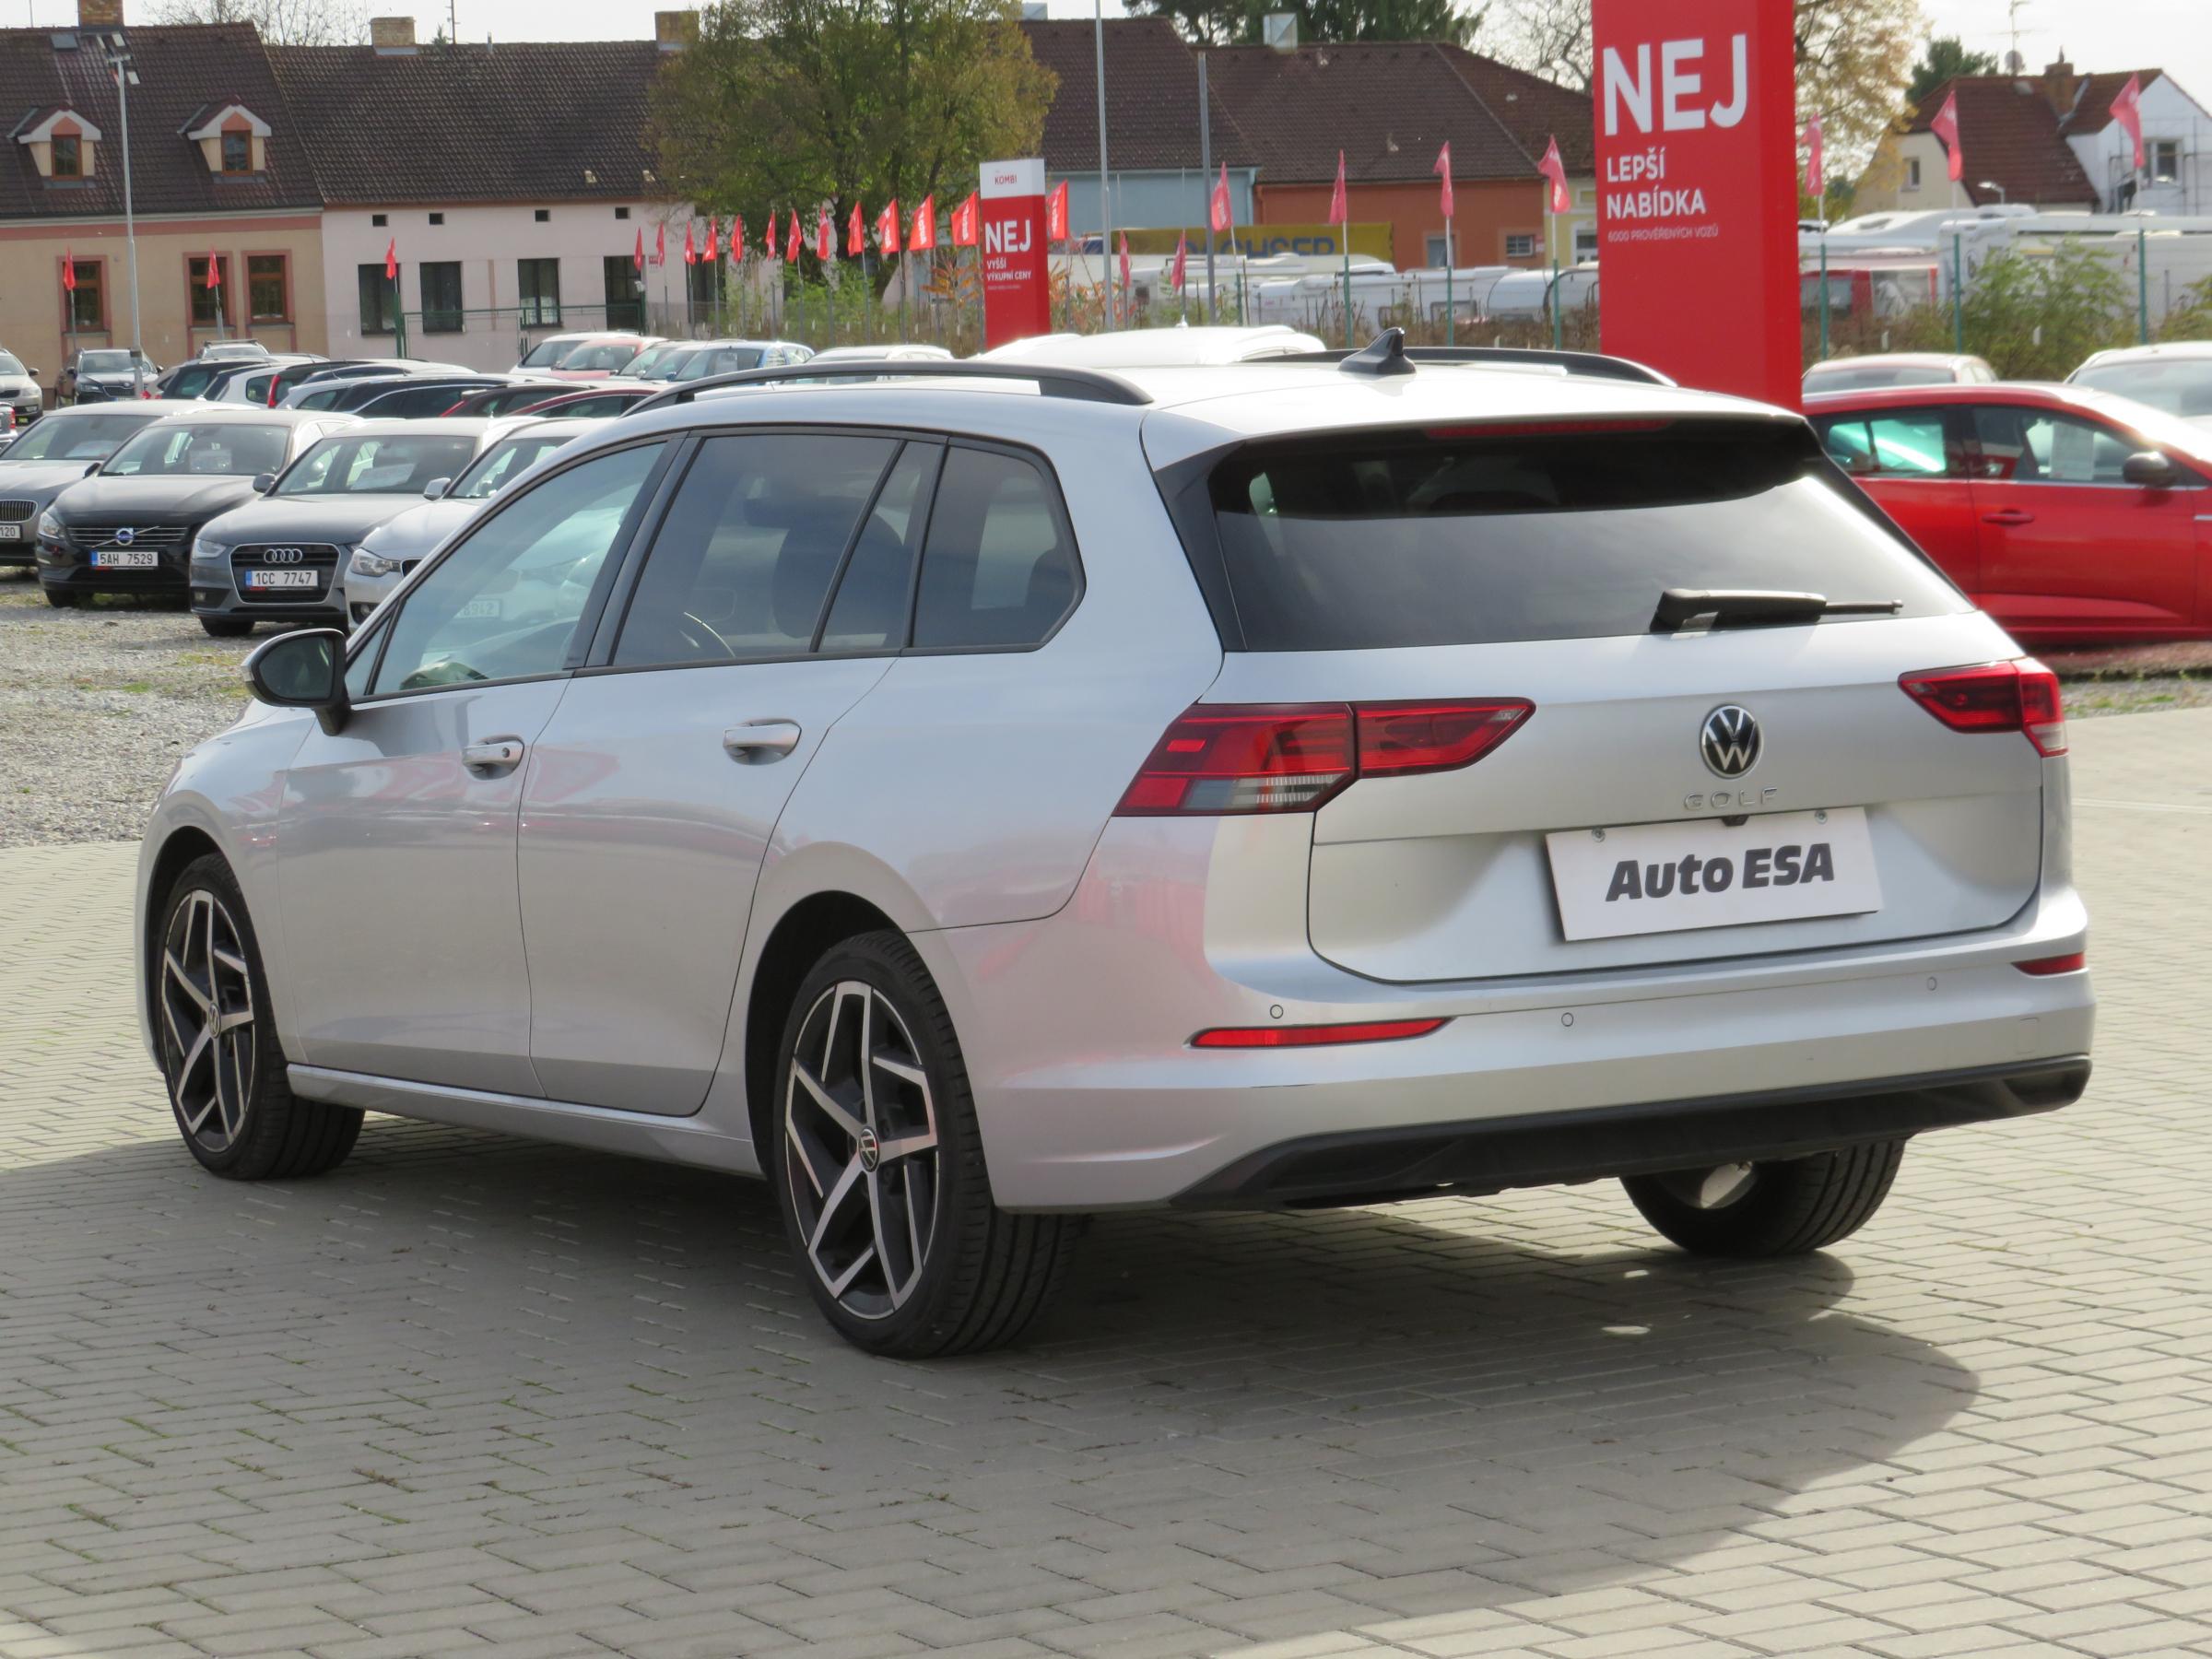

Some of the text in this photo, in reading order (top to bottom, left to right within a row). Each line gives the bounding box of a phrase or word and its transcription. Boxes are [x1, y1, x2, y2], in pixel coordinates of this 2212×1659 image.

[1603, 34, 1747, 136] NEJ
[1606, 147, 1665, 182] LEPŠÍ
[994, 174, 1018, 185] KOMBI
[1606, 185, 1706, 219] NABÍDKA
[985, 219, 1031, 253] NEJ
[1014, 270, 1032, 281] CENY
[0, 527, 16, 537] 120
[100, 554, 153, 565] 5AH 7529
[255, 572, 312, 585] 1CC 7747
[1684, 787, 1778, 810] GOLF
[1605, 842, 1835, 902] Auto ESA
